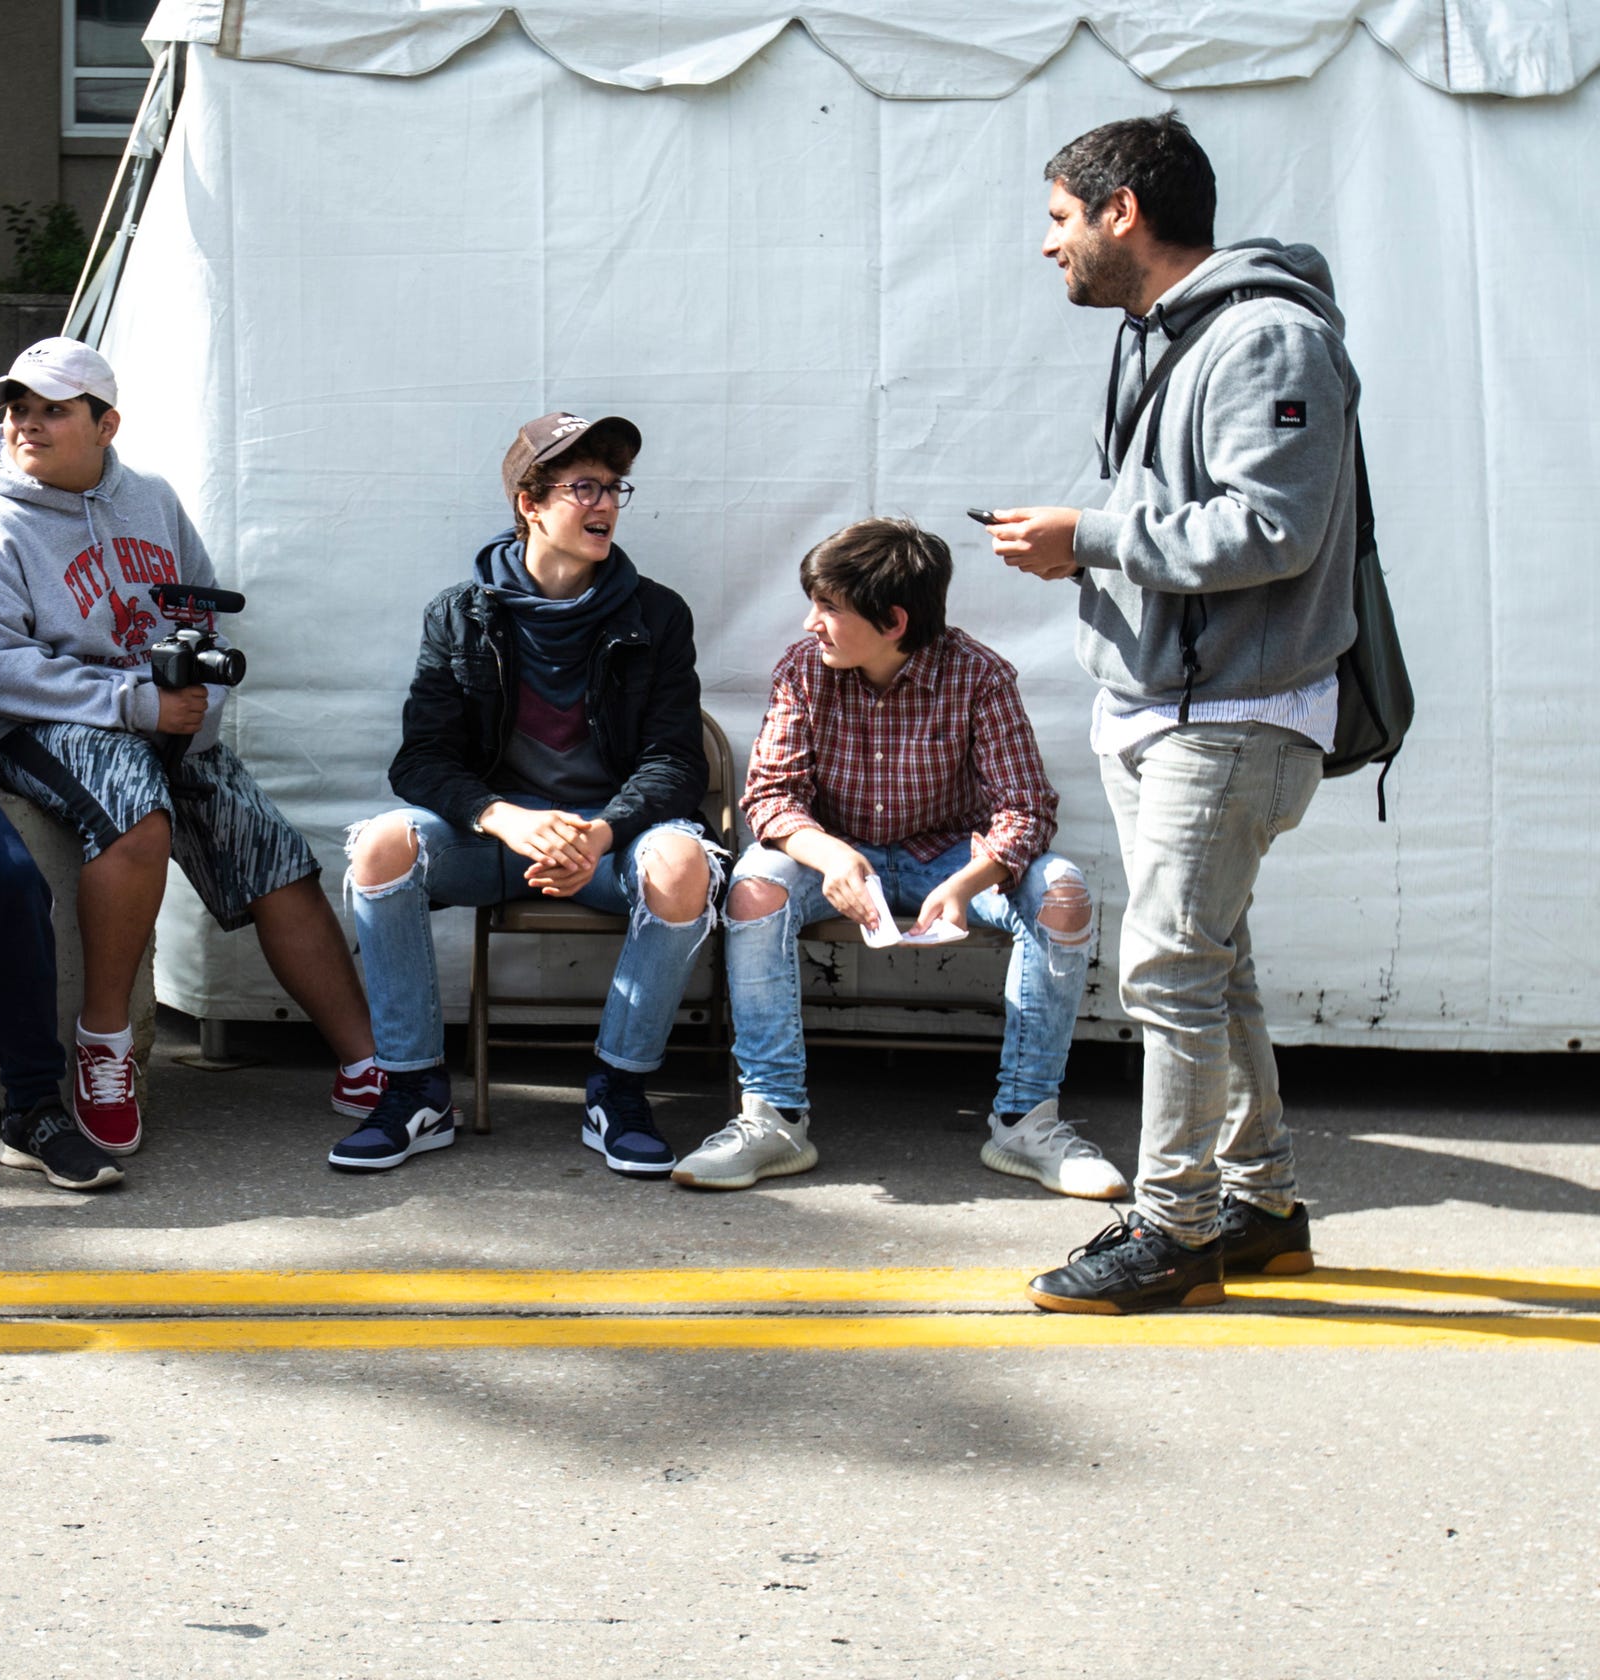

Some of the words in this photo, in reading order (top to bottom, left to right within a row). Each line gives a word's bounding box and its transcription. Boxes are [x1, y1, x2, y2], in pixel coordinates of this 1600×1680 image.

[64, 545, 111, 620] CITY
[111, 537, 179, 585] HIGH
[83, 654, 106, 664] THE
